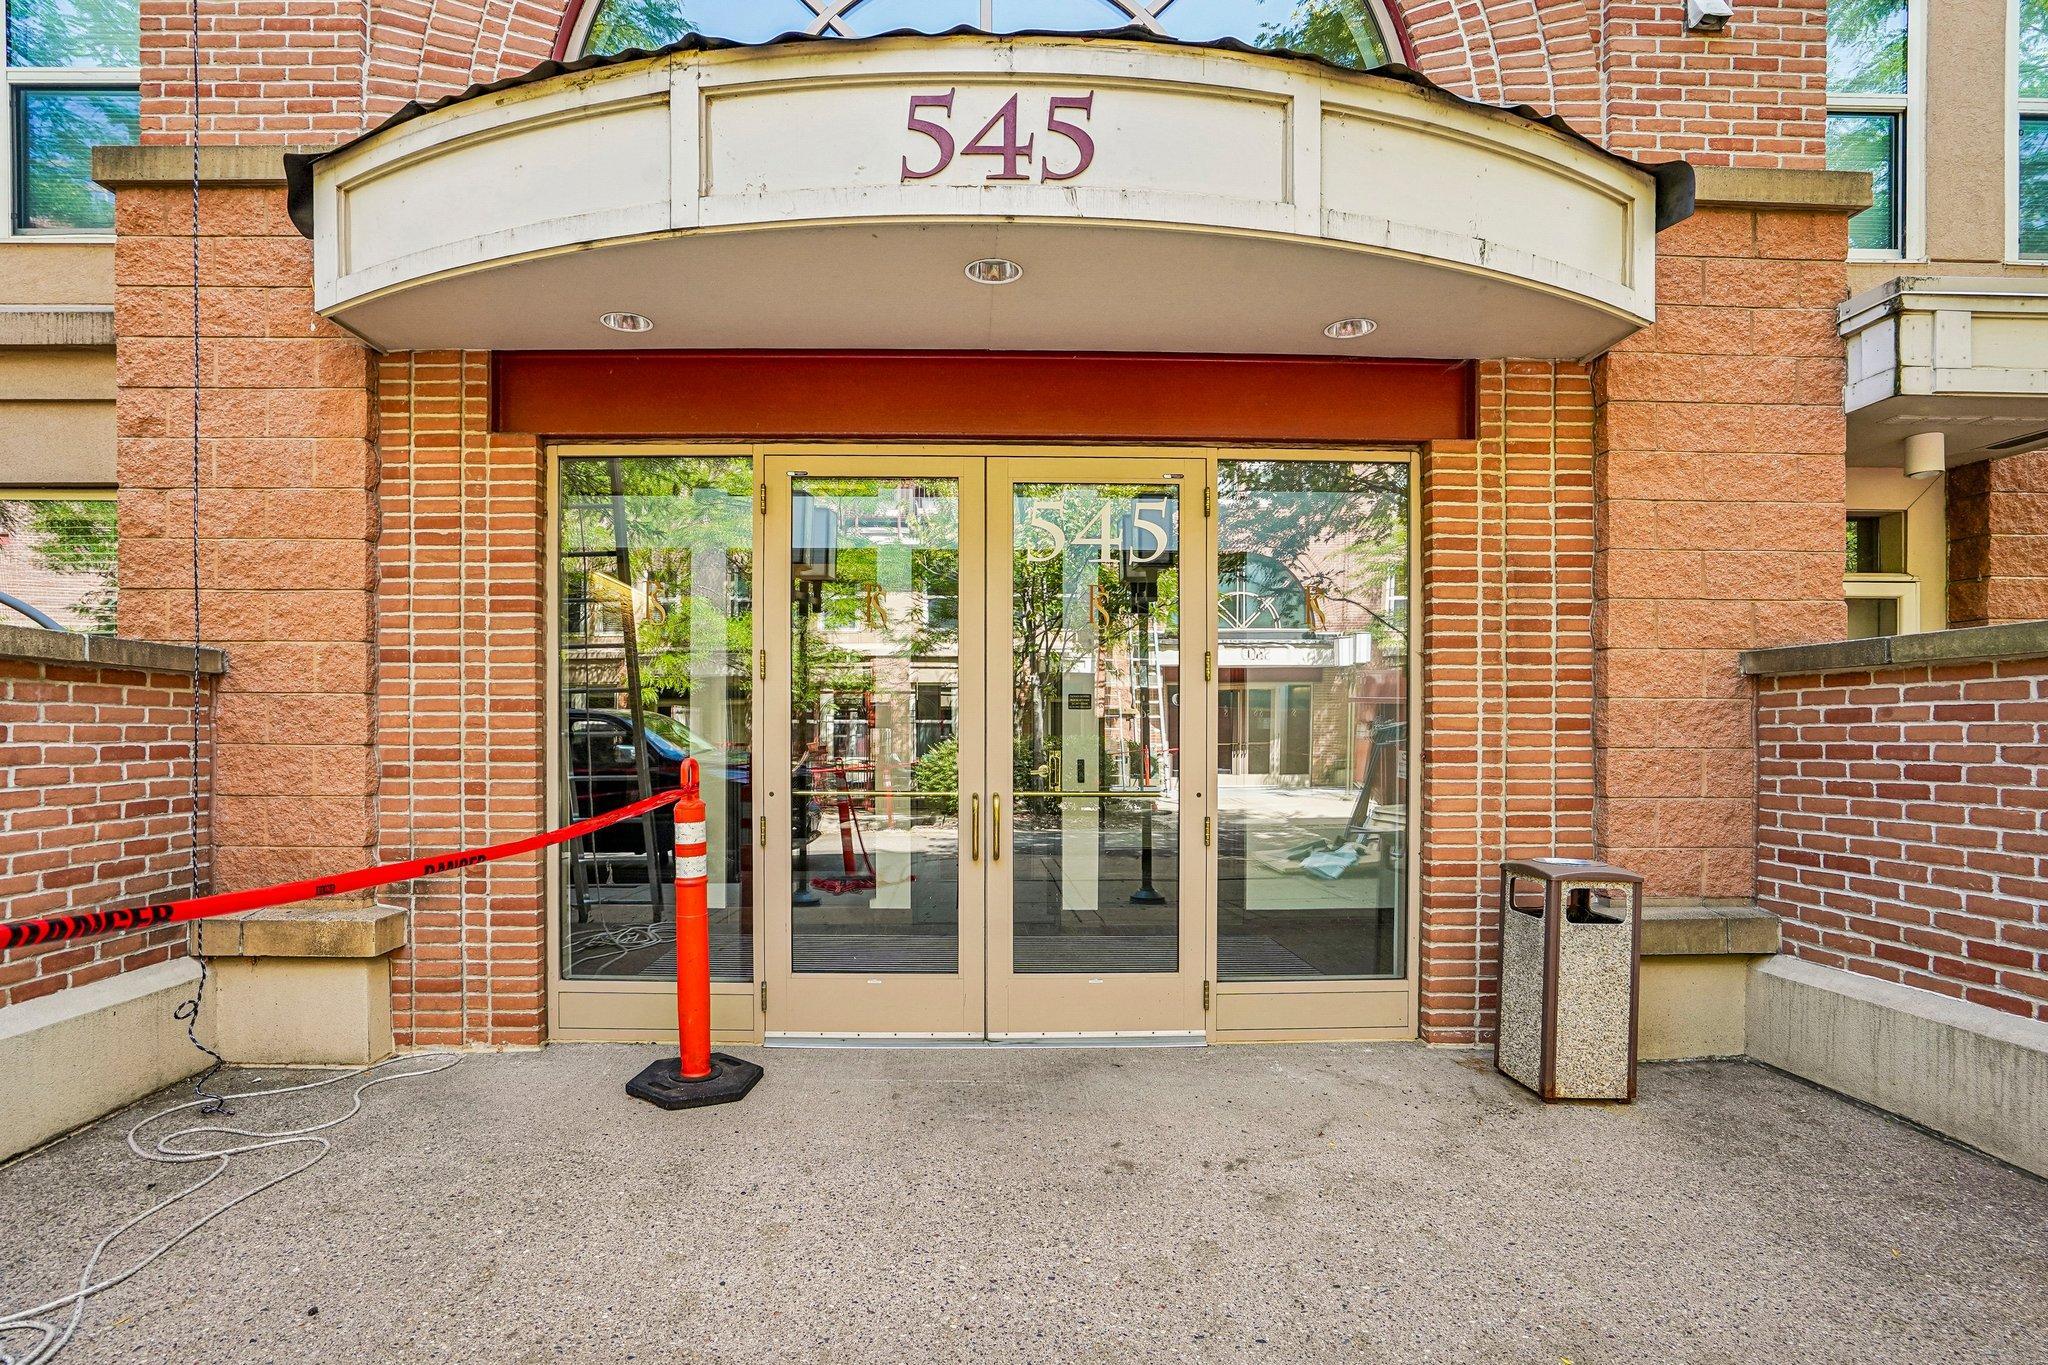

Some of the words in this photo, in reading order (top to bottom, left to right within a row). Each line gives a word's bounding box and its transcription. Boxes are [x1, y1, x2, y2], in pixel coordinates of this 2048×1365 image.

[901, 87, 1095, 184] 545
[1026, 497, 1168, 565] 545
[424, 854, 487, 876] DANGER
[7, 904, 174, 949] DANGER
